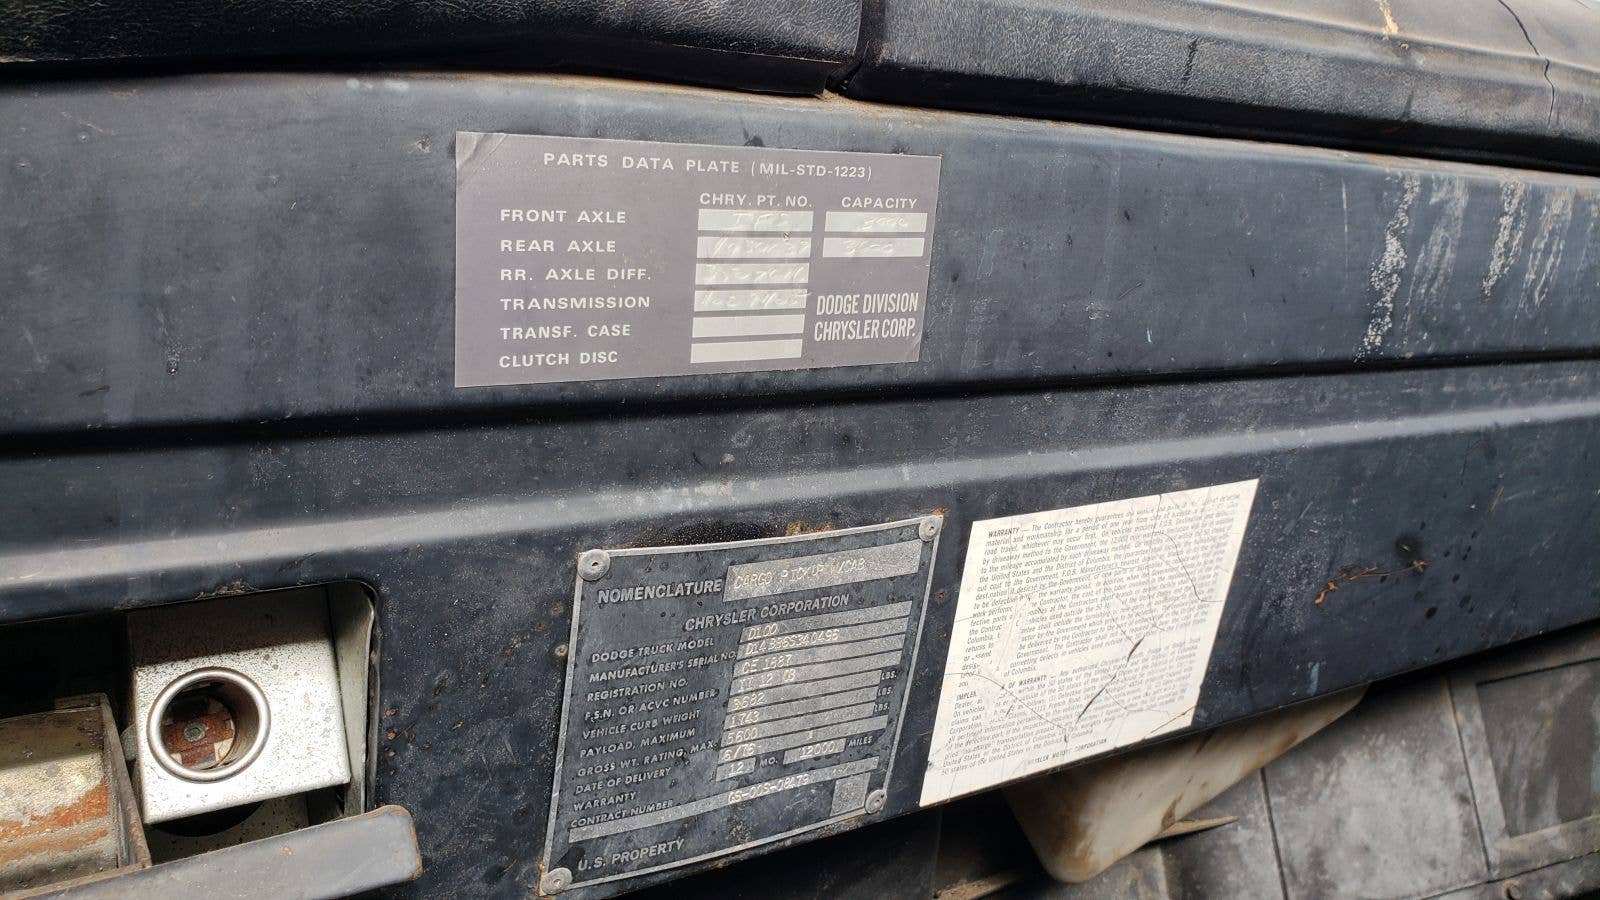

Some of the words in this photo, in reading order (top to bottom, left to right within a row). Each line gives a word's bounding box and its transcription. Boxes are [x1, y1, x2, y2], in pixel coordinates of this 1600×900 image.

[543, 152, 608, 168] PARTS
[621, 156, 674, 170] DATA
[685, 159, 740, 173] PLATE
[750, 160, 873, 182] (MIL-STD-1223)
[699, 192, 752, 206] CHRY.
[756, 194, 781, 206] PT.
[784, 194, 813, 207] NO.
[840, 196, 918, 209] CAPACITY
[500, 208, 566, 222] FRONT
[576, 210, 626, 223] AXLE
[499, 239, 555, 252] REAR
[566, 239, 616, 252] AXLE
[499, 268, 533, 281] RR.
[544, 268, 595, 281] AXLE
[605, 267, 652, 280] DIFF.
[499, 295, 651, 311] TRANSMISSION
[815, 293, 860, 315] DODGE
[861, 292, 919, 314] DIVISION
[499, 325, 577, 340] TRANSF.
[586, 323, 631, 337] CASE
[813, 318, 880, 341] CHRYSLER
[880, 317, 917, 338] CORP.
[498, 352, 569, 368] CLUTCH
[579, 350, 618, 364] DISC
[596, 574, 723, 607] NOMENCLATURE
[732, 570, 774, 589] CARGO
[683, 608, 756, 632] CHRYSLER
[759, 592, 850, 619] CORPORATION
[590, 647, 634, 664] DODGE
[636, 642, 674, 657] TRUCK
[676, 636, 715, 651] MODEL
[747, 622, 778, 640] D100
[588, 658, 684, 684] MANUFACTURER'S
[686, 653, 719, 669] SERIAL
[719, 649, 737, 661] NO.
[586, 680, 665, 703] REGISTRATION
[668, 676, 690, 689] NO.
[581, 723, 626, 740] VEHICLE
[629, 717, 659, 732] CURB
[661, 709, 701, 725] WEIGHT
[880, 669, 898, 680] LBS.
[583, 707, 615, 723] F.S.N.
[617, 703, 636, 716] OR
[671, 687, 719, 706] NUMBER
[578, 739, 637, 760] PAYLOAD,
[639, 727, 696, 748] MAXIMUM
[876, 685, 894, 697] LBS.
[576, 761, 616, 778] GROSS
[620, 756, 640, 769] WT.
[643, 747, 687, 765] RATING,
[689, 738, 718, 753] MAX.
[873, 700, 891, 712] LBS.
[572, 790, 637, 813] WARRANTY
[728, 760, 745, 777] 12
[758, 754, 779, 767] MO.
[798, 739, 836, 759] 12000
[847, 734, 873, 748] MILES
[574, 780, 603, 795] DATE
[606, 776, 621, 788] OF
[624, 766, 671, 785] DELIVERY
[569, 808, 627, 830] CONTRACT
[629, 798, 674, 816] NUMBER
[576, 854, 607, 873] U.S.
[610, 835, 685, 867] PROPERTY
